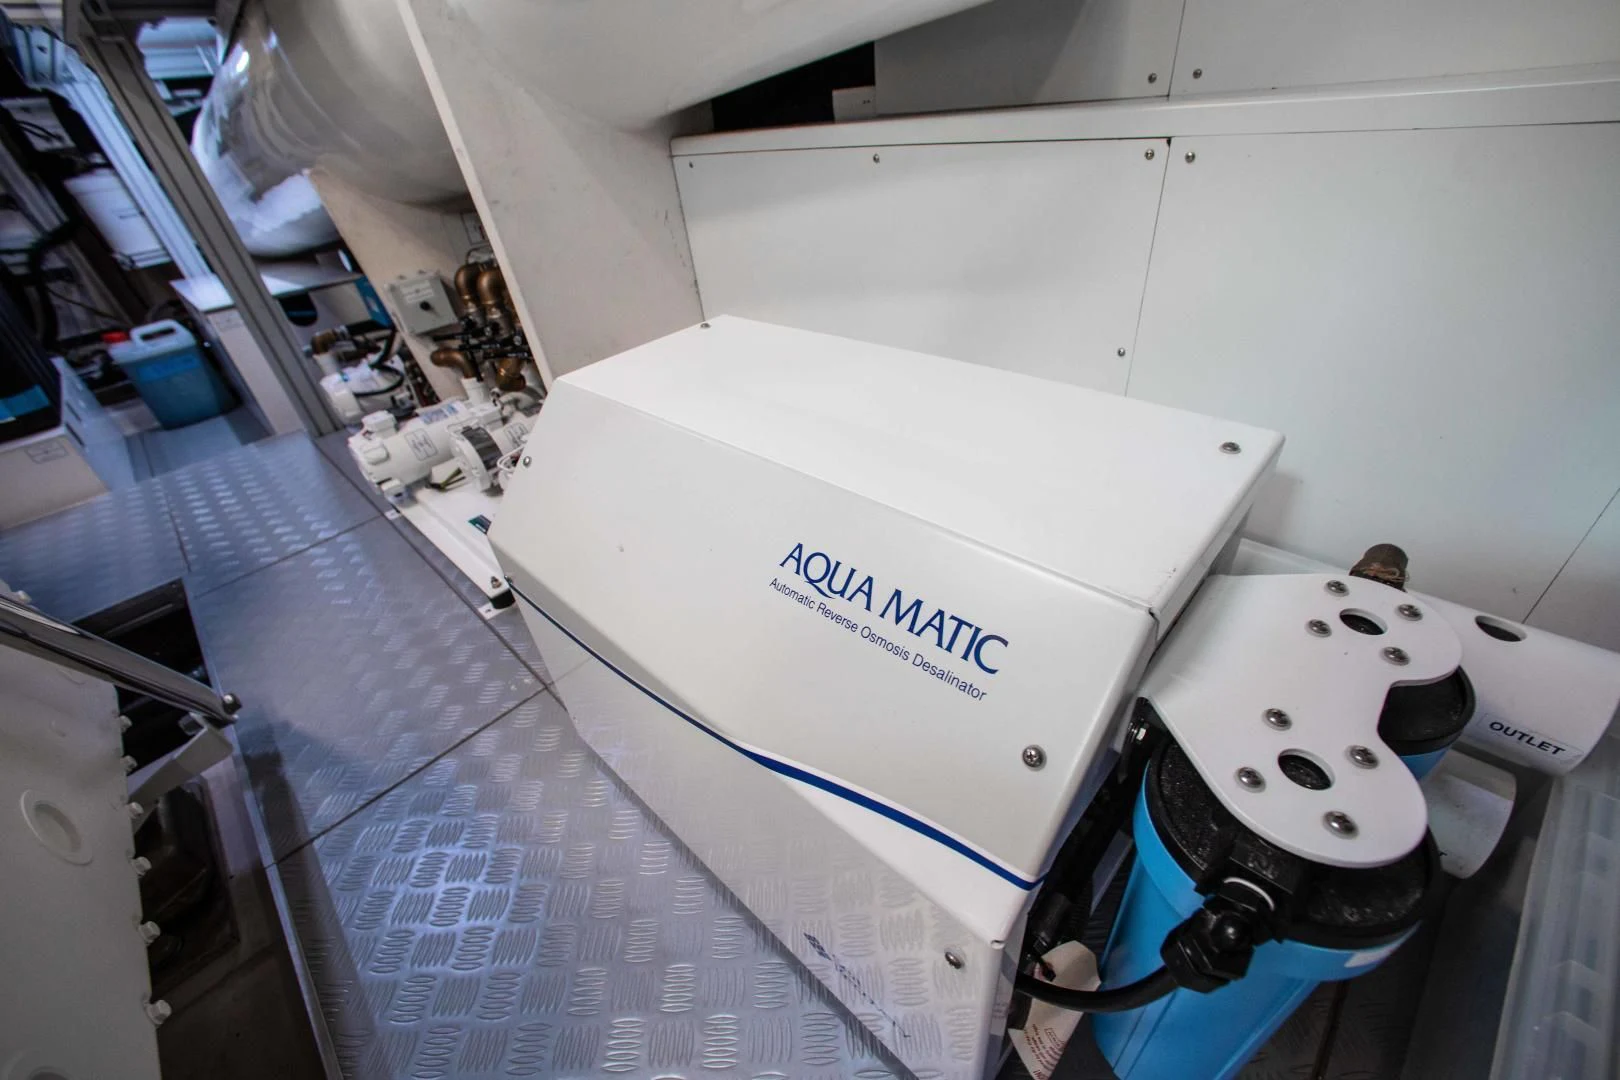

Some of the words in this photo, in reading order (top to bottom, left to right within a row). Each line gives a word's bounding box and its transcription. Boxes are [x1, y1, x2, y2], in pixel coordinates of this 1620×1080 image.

[769, 577, 815, 610] Automatic
[816, 602, 858, 633] Reverse
[860, 626, 910, 662] Osmosis
[911, 653, 987, 701] Desalinator
[779, 542, 874, 612] AQUA
[879, 588, 1009, 675] MATIC
[1489, 721, 1566, 755] OUTLET
